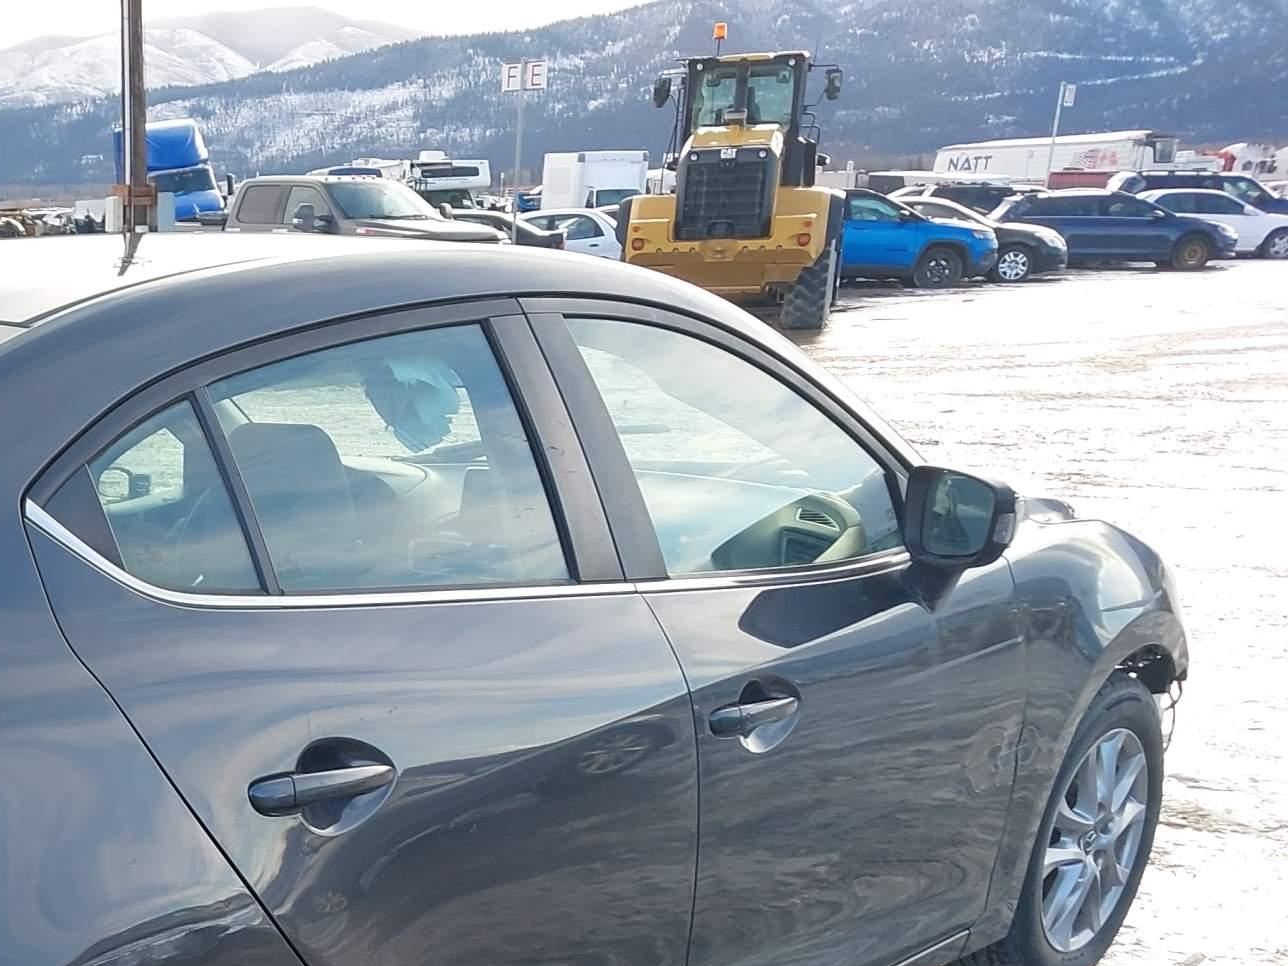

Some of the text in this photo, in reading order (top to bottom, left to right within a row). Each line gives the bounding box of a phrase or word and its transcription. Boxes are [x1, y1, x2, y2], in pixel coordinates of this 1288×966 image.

[507, 64, 543, 88] F E
[720, 148, 738, 159] CAT
[947, 155, 993, 172] NATT
